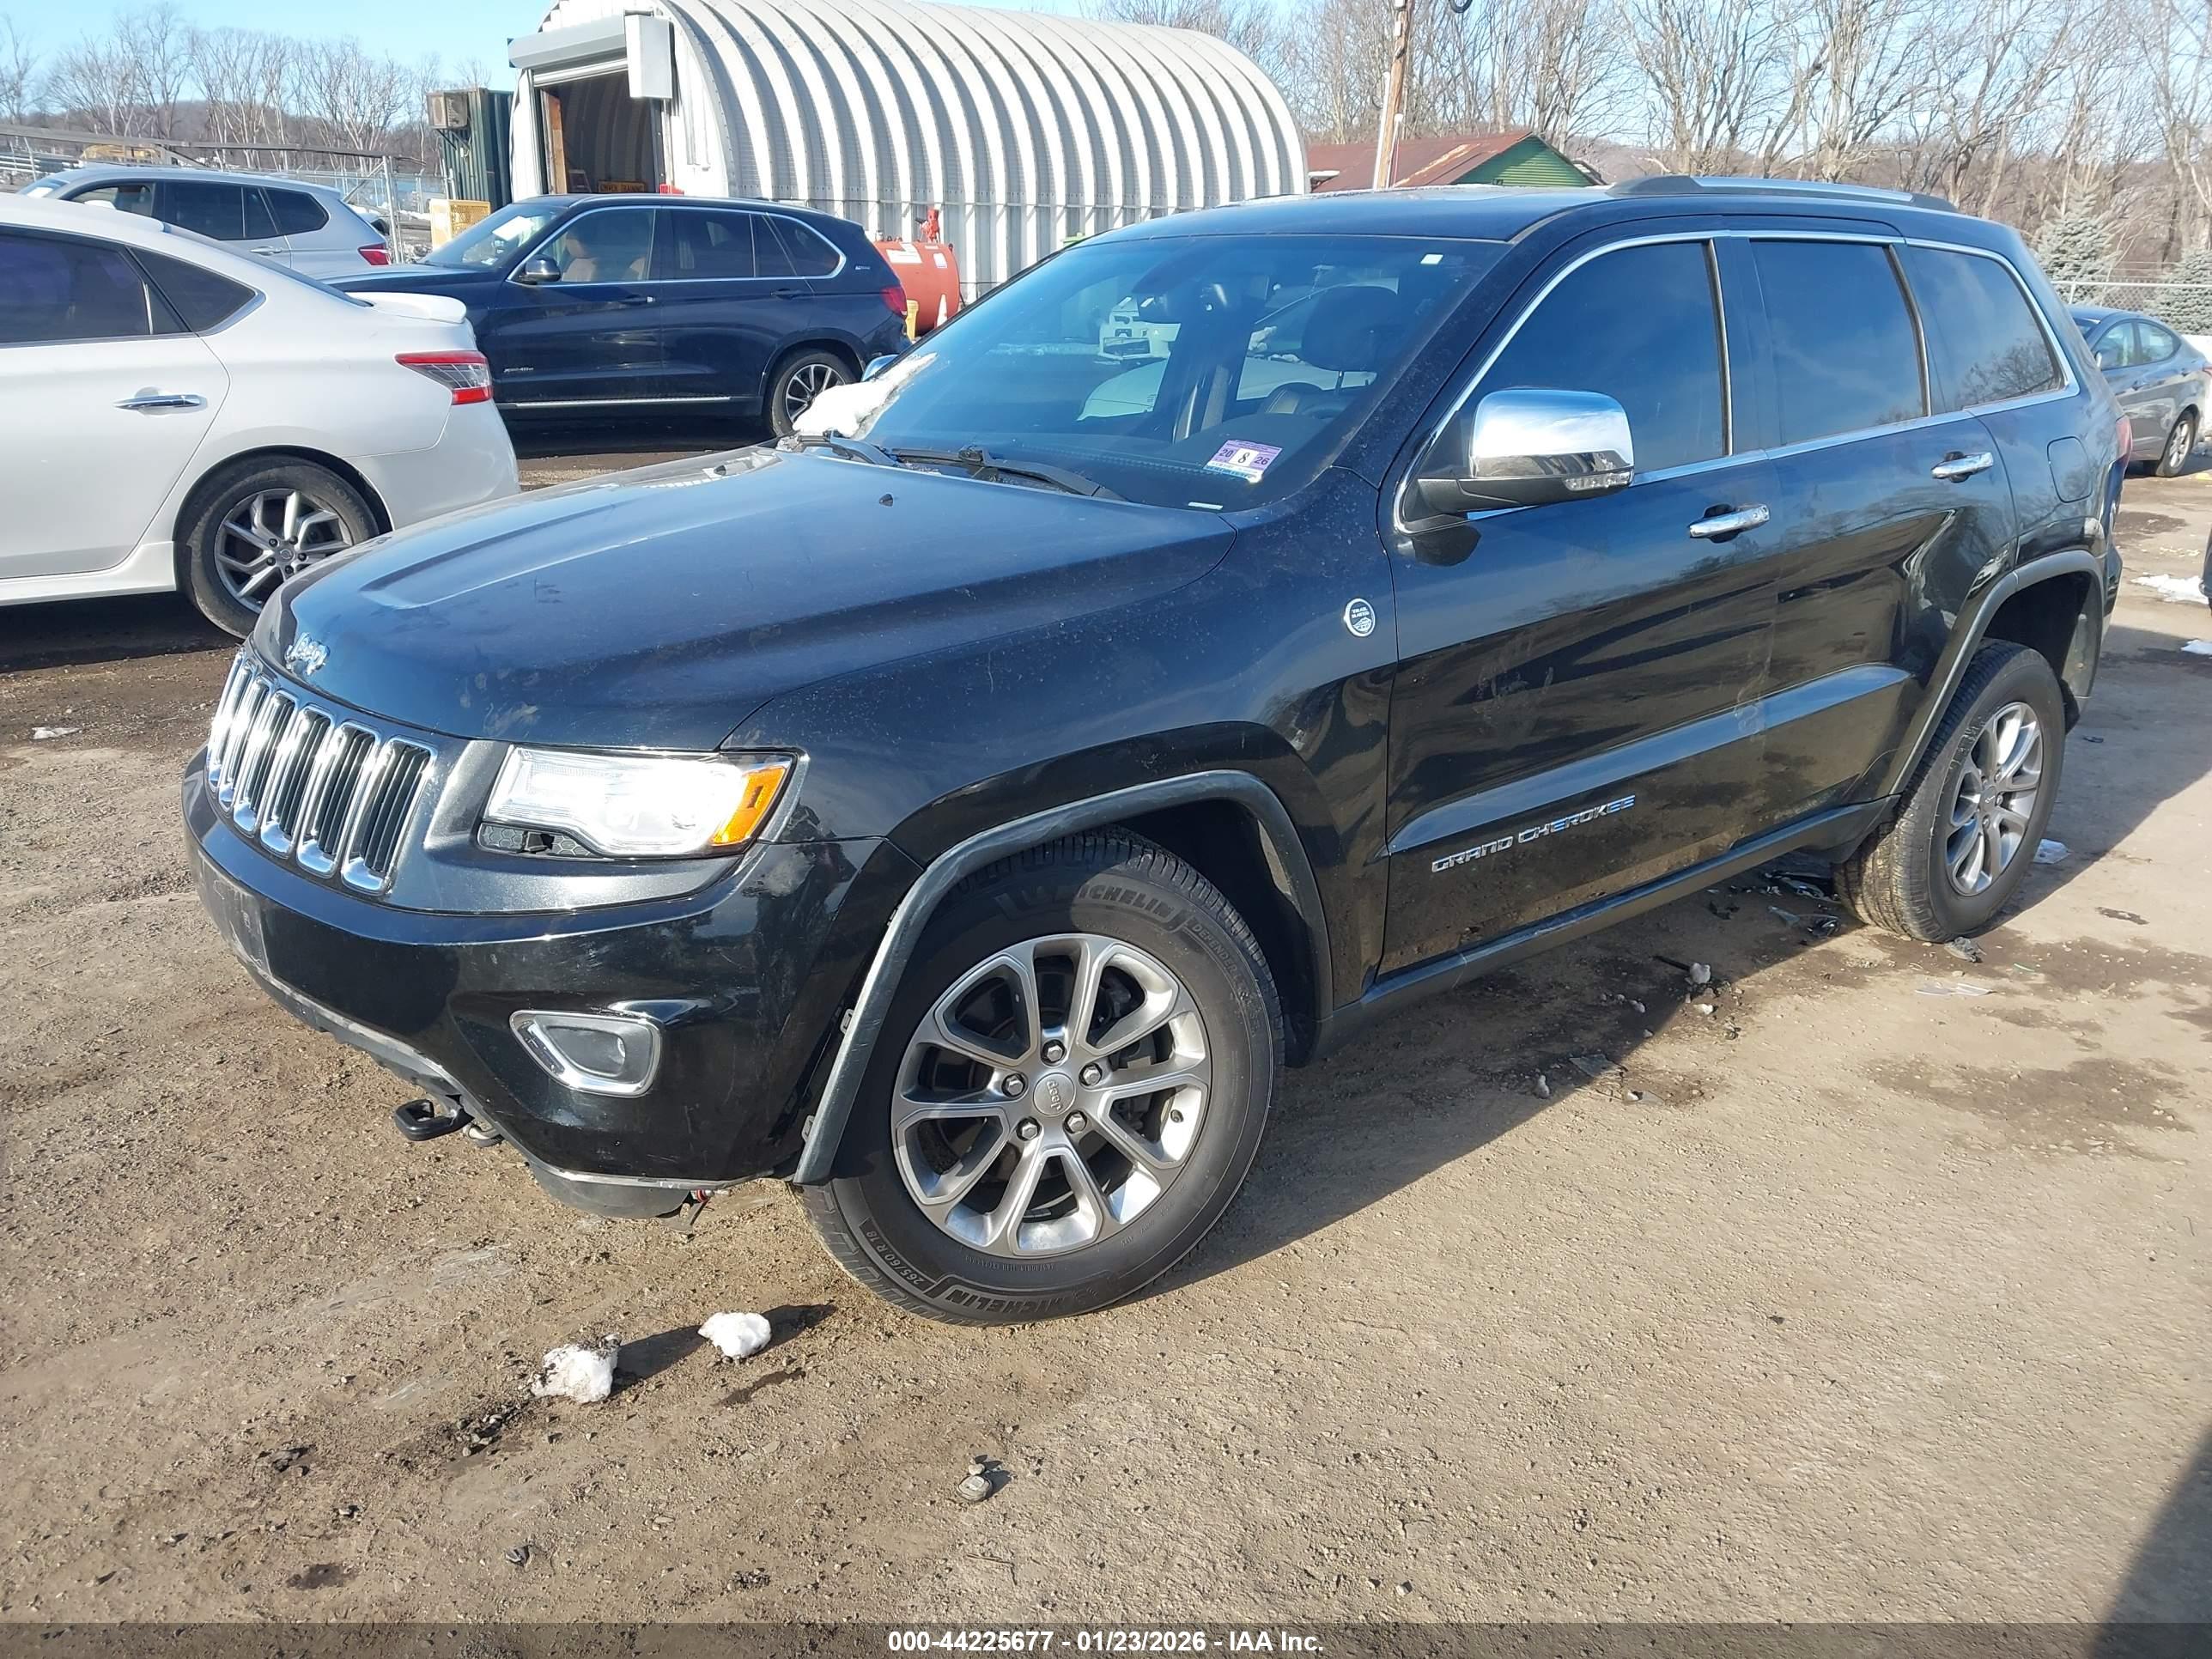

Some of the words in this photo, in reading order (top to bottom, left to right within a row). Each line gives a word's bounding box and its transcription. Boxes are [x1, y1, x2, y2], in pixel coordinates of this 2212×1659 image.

[1219, 448, 1234, 458] 20
[1237, 452, 1250, 464] 8
[1254, 456, 1270, 465] 26
[1431, 836, 1514, 873] GRAND
[1517, 794, 1636, 845] CHEROKEE
